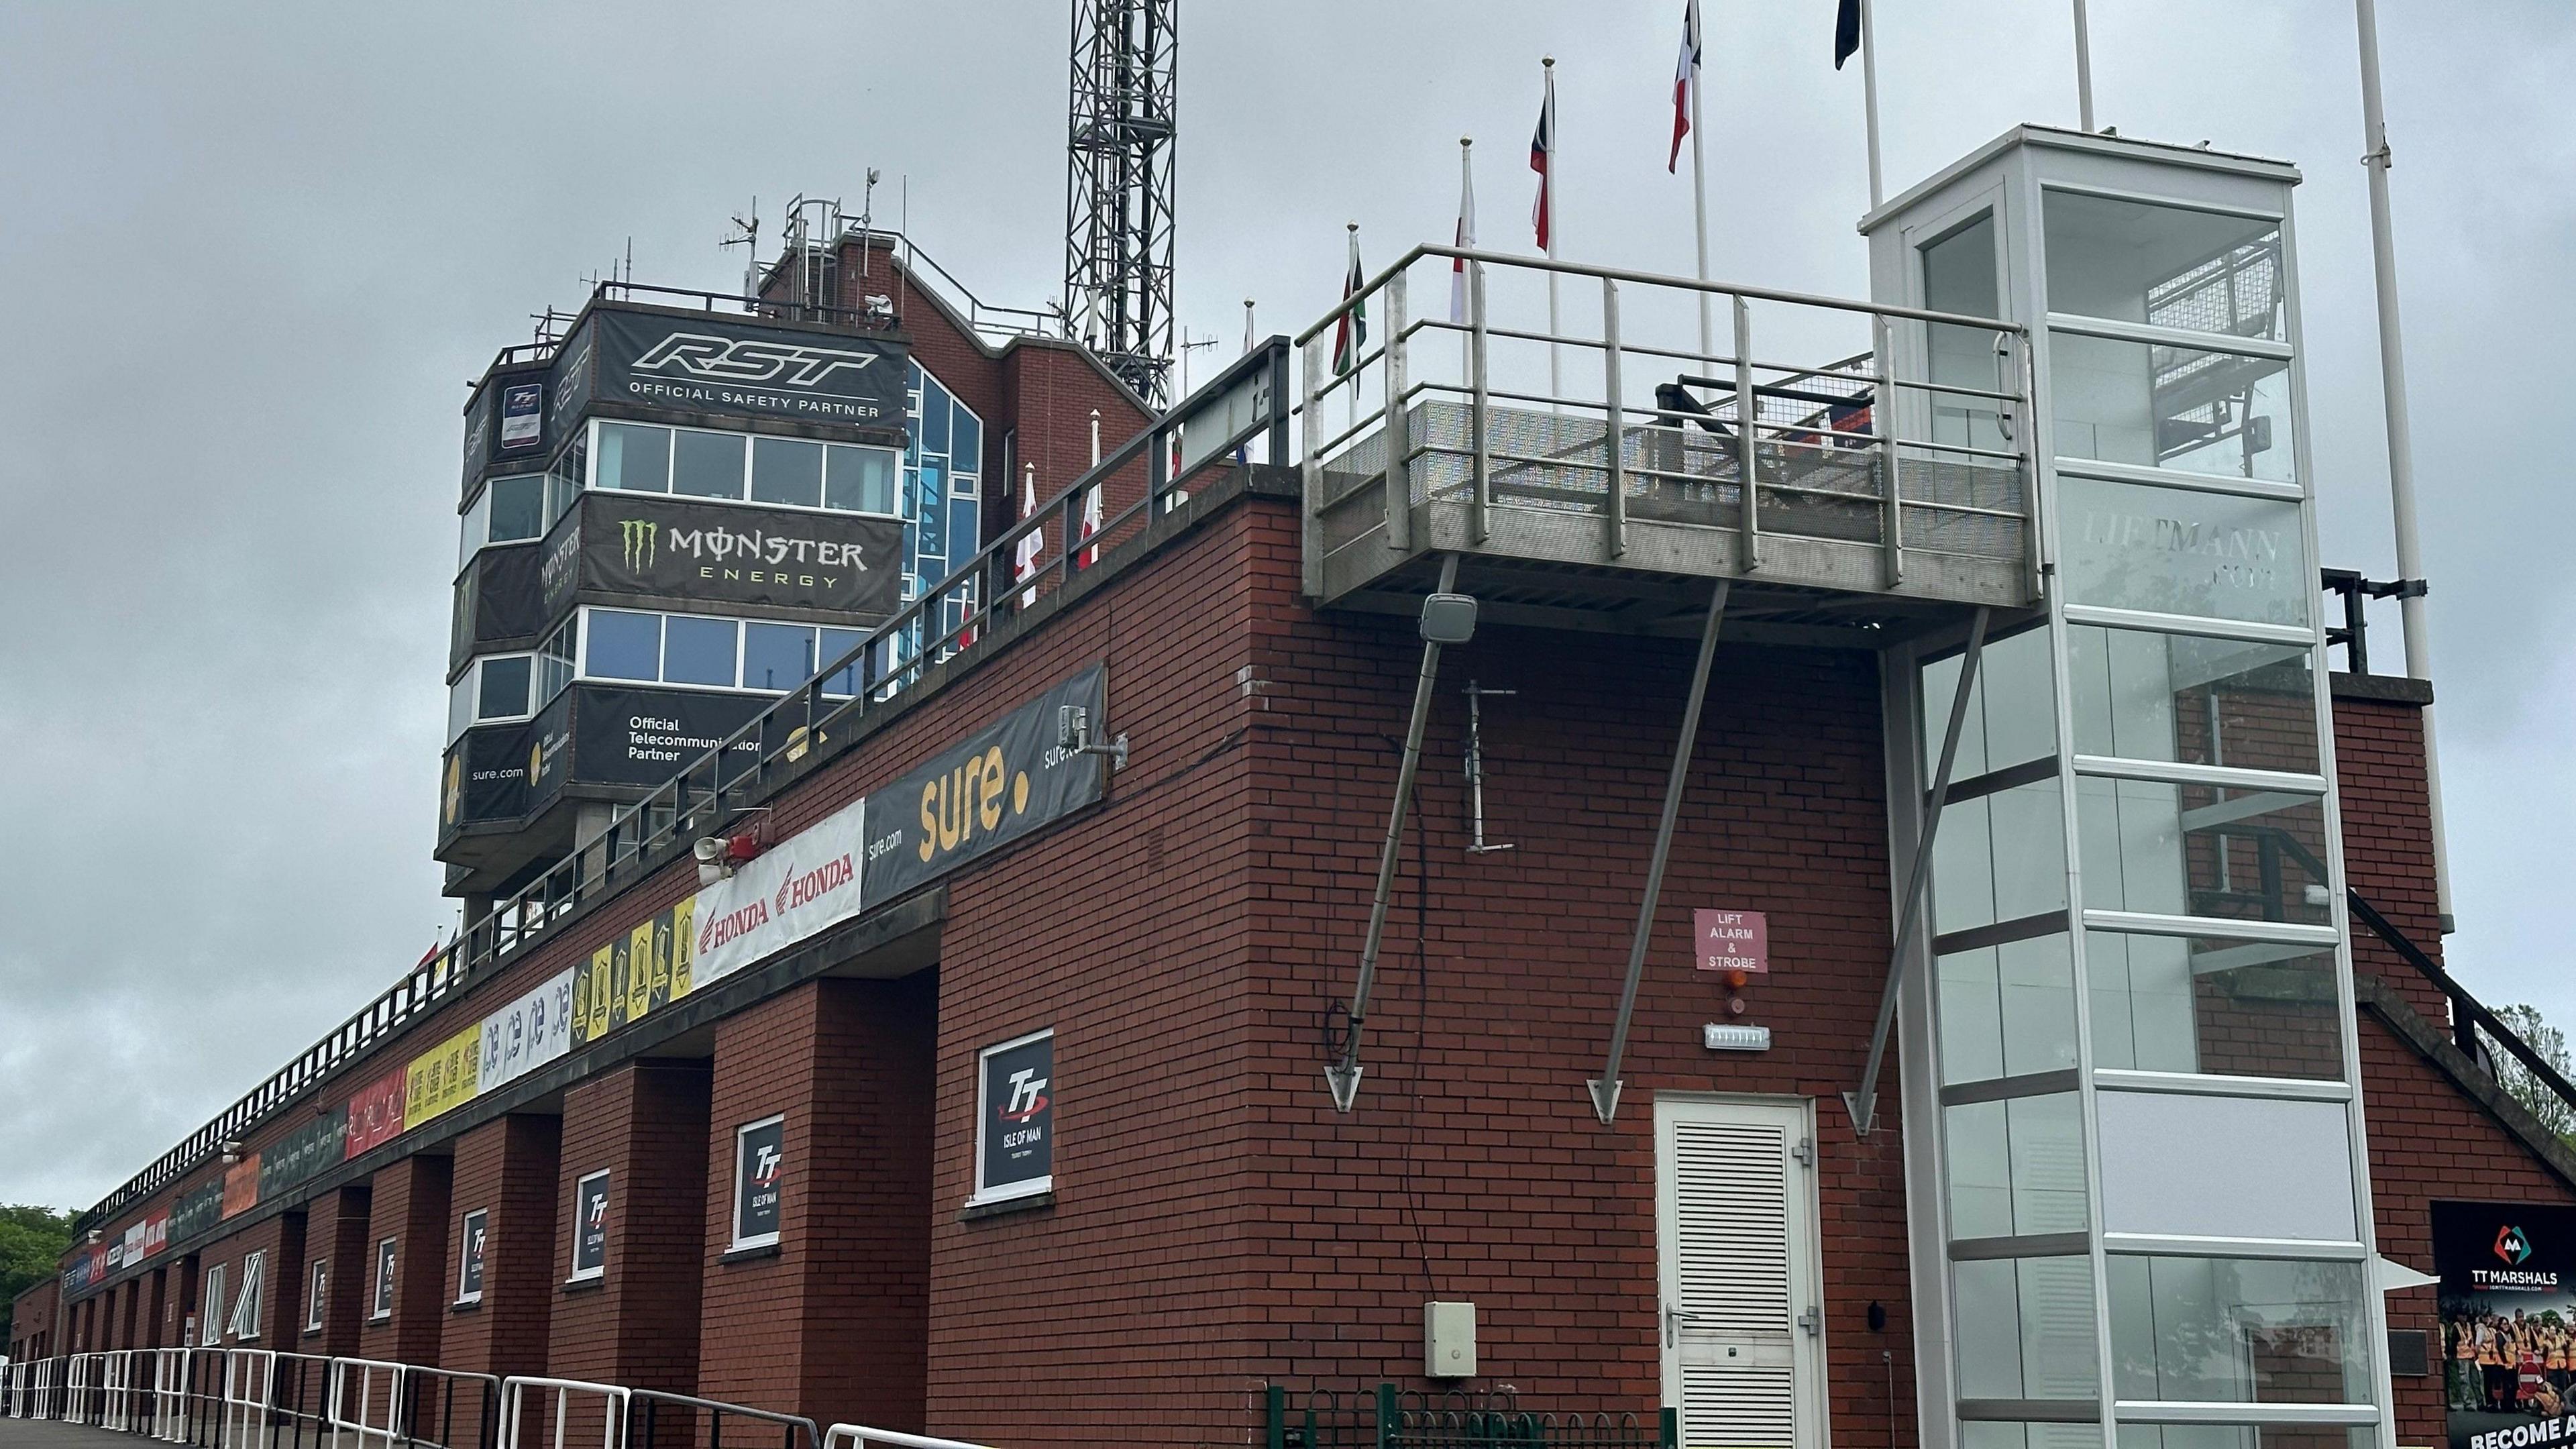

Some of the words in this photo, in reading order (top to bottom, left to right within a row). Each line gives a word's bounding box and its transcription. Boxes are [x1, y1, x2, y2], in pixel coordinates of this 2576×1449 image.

[631, 332, 879, 386] RST
[629, 382, 714, 401] OFFICIAL
[722, 391, 792, 409] SAFETY
[798, 399, 879, 418] PARTNER
[669, 526, 868, 572] MONSTER
[700, 566, 838, 588] ENERGY
[629, 716, 680, 731] Official
[629, 747, 680, 762] Partner
[472, 767, 524, 781] sure.com
[869, 828, 902, 861] sure.com
[790, 853, 853, 910] HONDA
[713, 898, 769, 948] HONDA
[1717, 914, 1743, 925] LIFT
[1710, 926, 1754, 940] ALARM
[1727, 942, 1736, 953] &
[1709, 956, 1756, 969] STROBE
[1008, 1067, 1048, 1124] TT
[1004, 1133, 1017, 1148] ISLE
[1017, 1130, 1026, 1145] OF
[1026, 1126, 1041, 1144] MAN
[756, 1144, 782, 1189] TT
[590, 1193, 608, 1230] TT
[2471, 1270, 2487, 1283] TT
[2489, 1271, 2558, 1285] MARSHALS
[2471, 1418, 2561, 1449] BECOME
